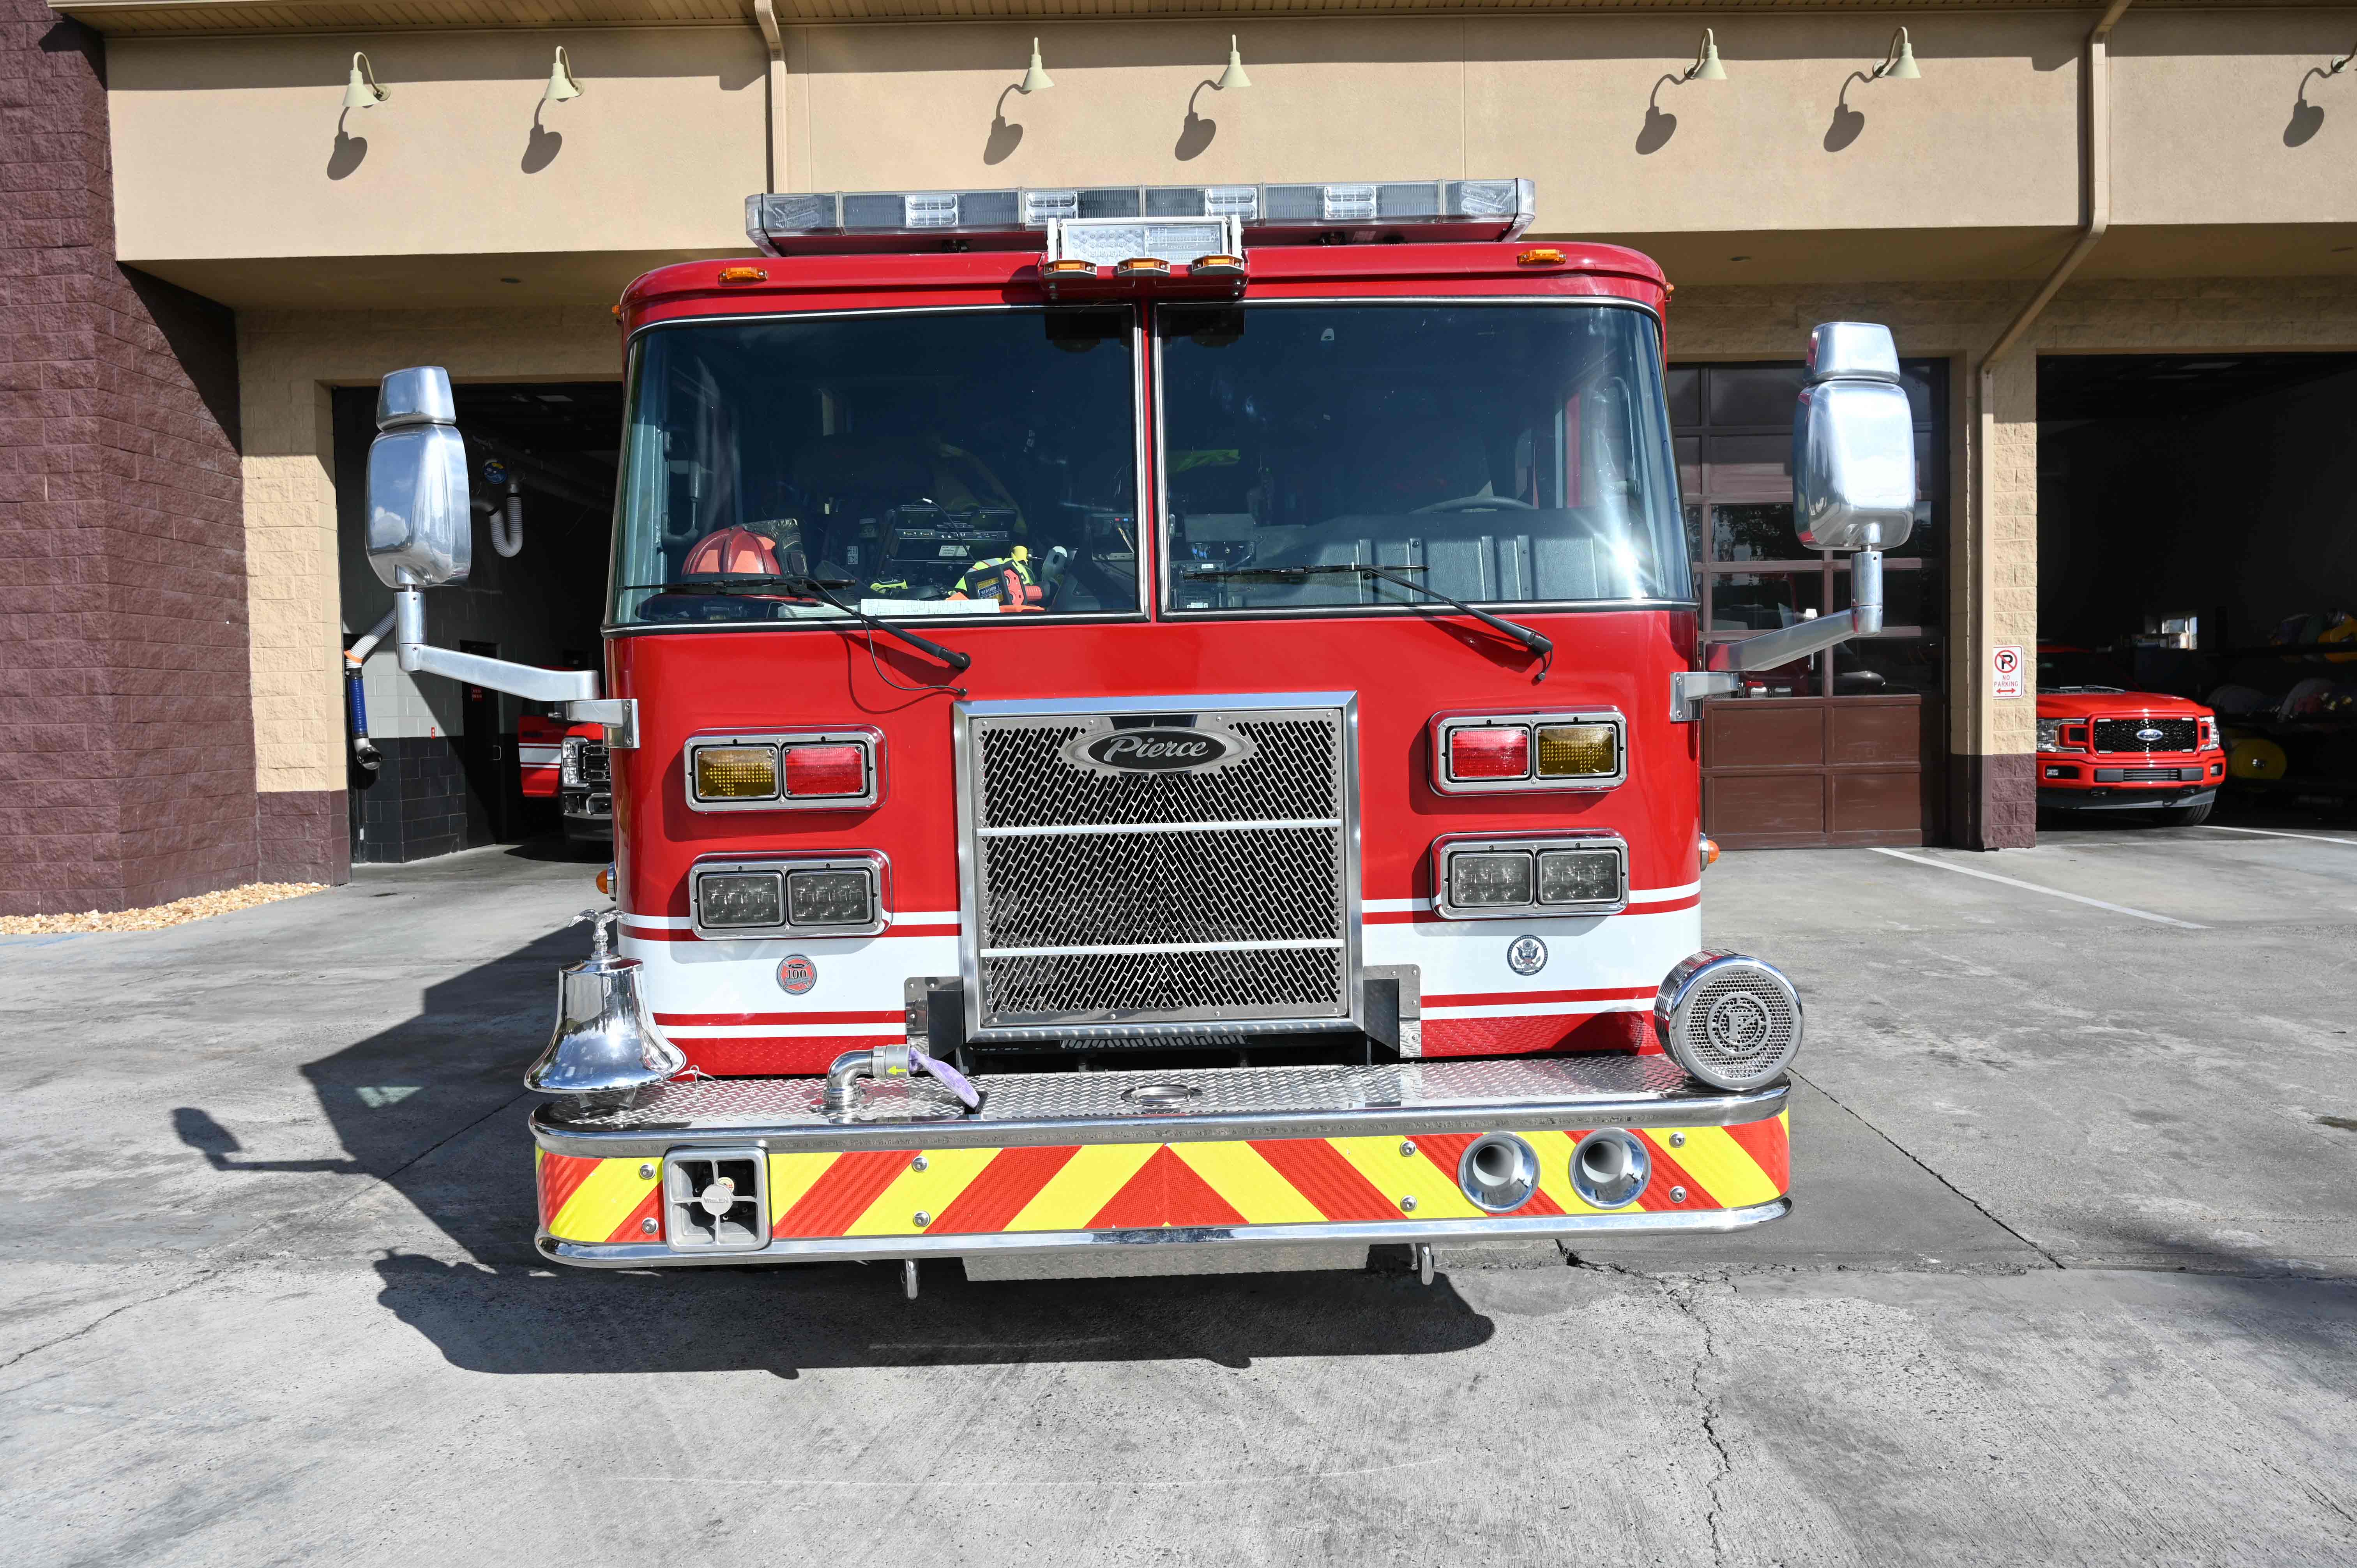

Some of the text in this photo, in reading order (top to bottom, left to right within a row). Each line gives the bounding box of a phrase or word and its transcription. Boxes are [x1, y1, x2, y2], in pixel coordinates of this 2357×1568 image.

[981, 586, 997, 595] STATION
[1103, 736, 1209, 762] Pierce
[786, 969, 807, 979] 100
